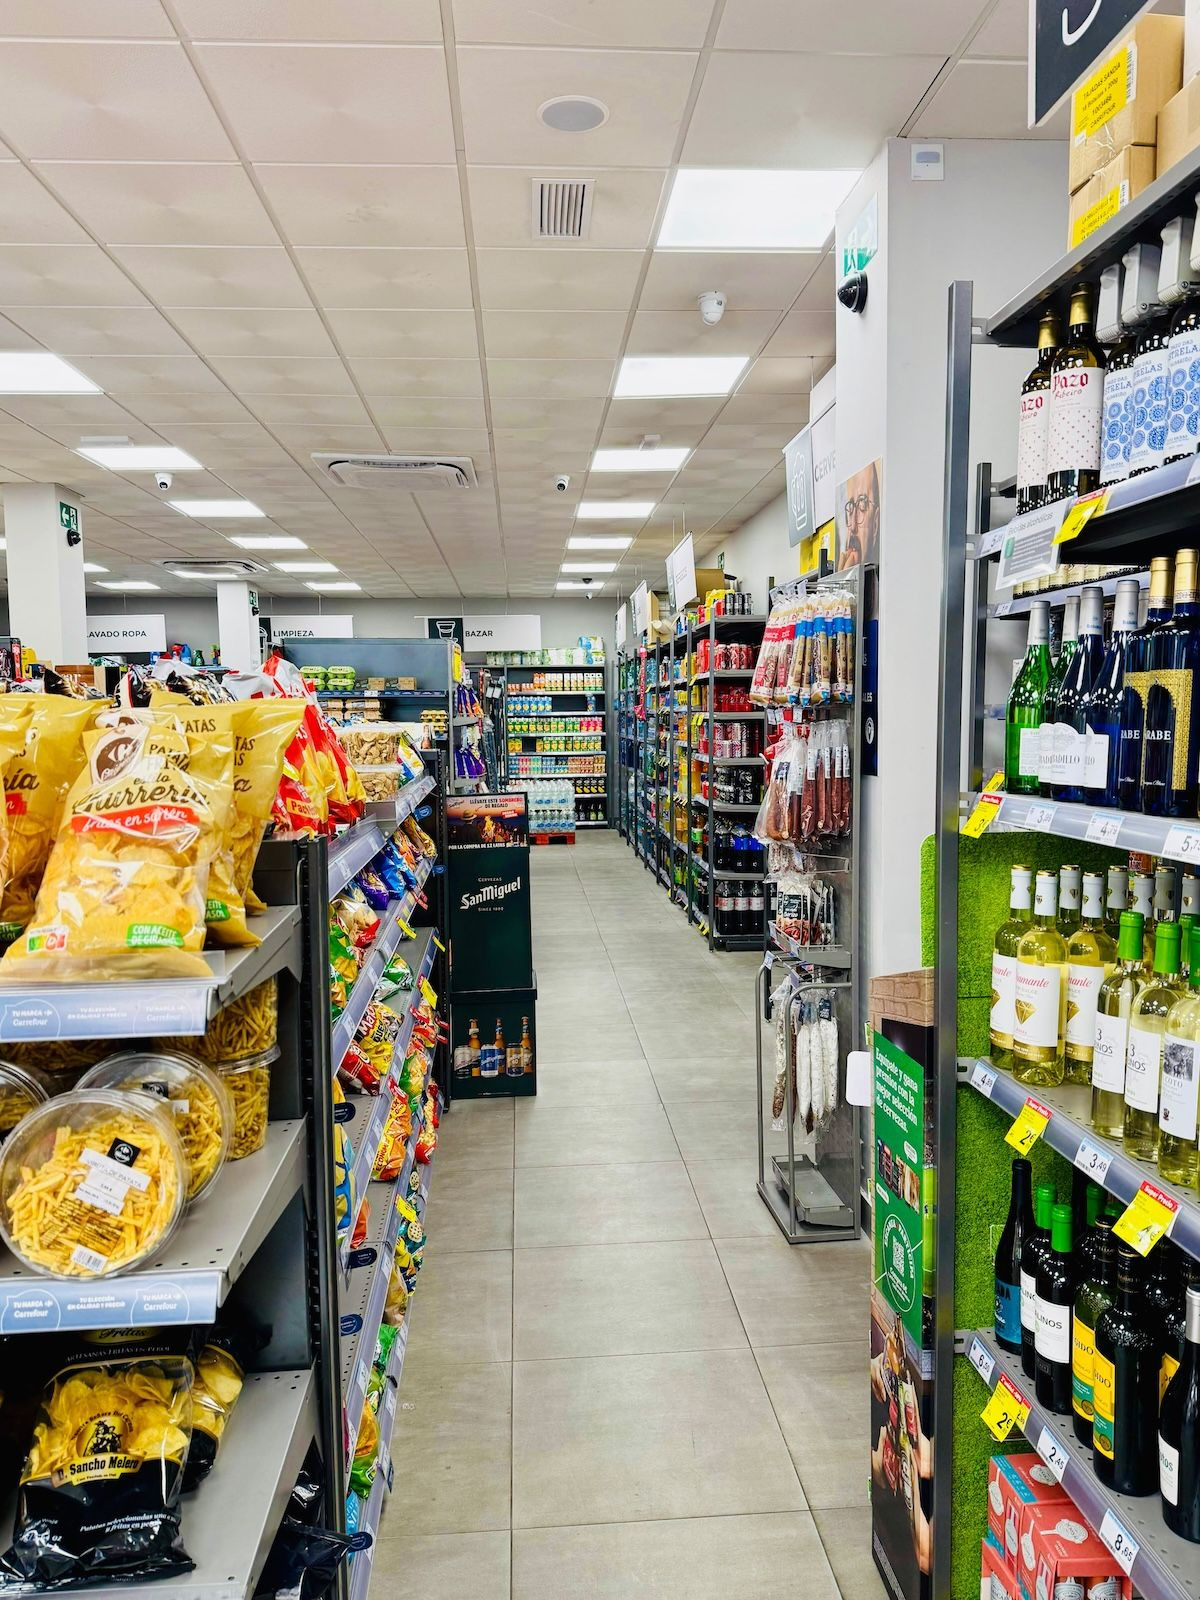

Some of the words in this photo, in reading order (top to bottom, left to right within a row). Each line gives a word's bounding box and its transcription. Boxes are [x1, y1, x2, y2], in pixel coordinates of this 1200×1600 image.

[87, 630, 120, 638] AVADO
[122, 630, 147, 638] ROPA
[273, 630, 314, 638] LIMPIEZA
[465, 630, 493, 638] BAZAR
[20, 1009, 42, 1017] MARCA
[13, 1018, 48, 1027] Carrefour
[1096, 1028, 1102, 1041] 3
[1130, 1044, 1136, 1057] 3
[876, 1066, 898, 1091] premios
[898, 1084, 909, 1102] con
[908, 1090, 915, 1107] la
[903, 1073, 918, 1093] gana
[876, 1081, 892, 1101] mejor
[891, 1095, 918, 1127] selección
[876, 1094, 883, 1109] de
[883, 1103, 909, 1134] cervezas.
[1089, 1153, 1107, 1172] 3,49
[1144, 1184, 1158, 1198] Super
[1157, 1193, 1174, 1208] Precio
[14, 1310, 49, 1319] Carrefour
[143, 1303, 178, 1312] Carrefour
[996, 1412, 1013, 1430] 2€
[69, 1457, 106, 1476] Sancho
[108, 1456, 139, 1469] Melero
[1048, 1446, 1065, 1470] 2,45
[80, 1522, 106, 1533] Patatas
[106, 1513, 153, 1526] seleccionadas
[109, 1522, 131, 1532] fritas
[131, 1521, 141, 1529] en
[1114, 1533, 1134, 1562] 8,65
